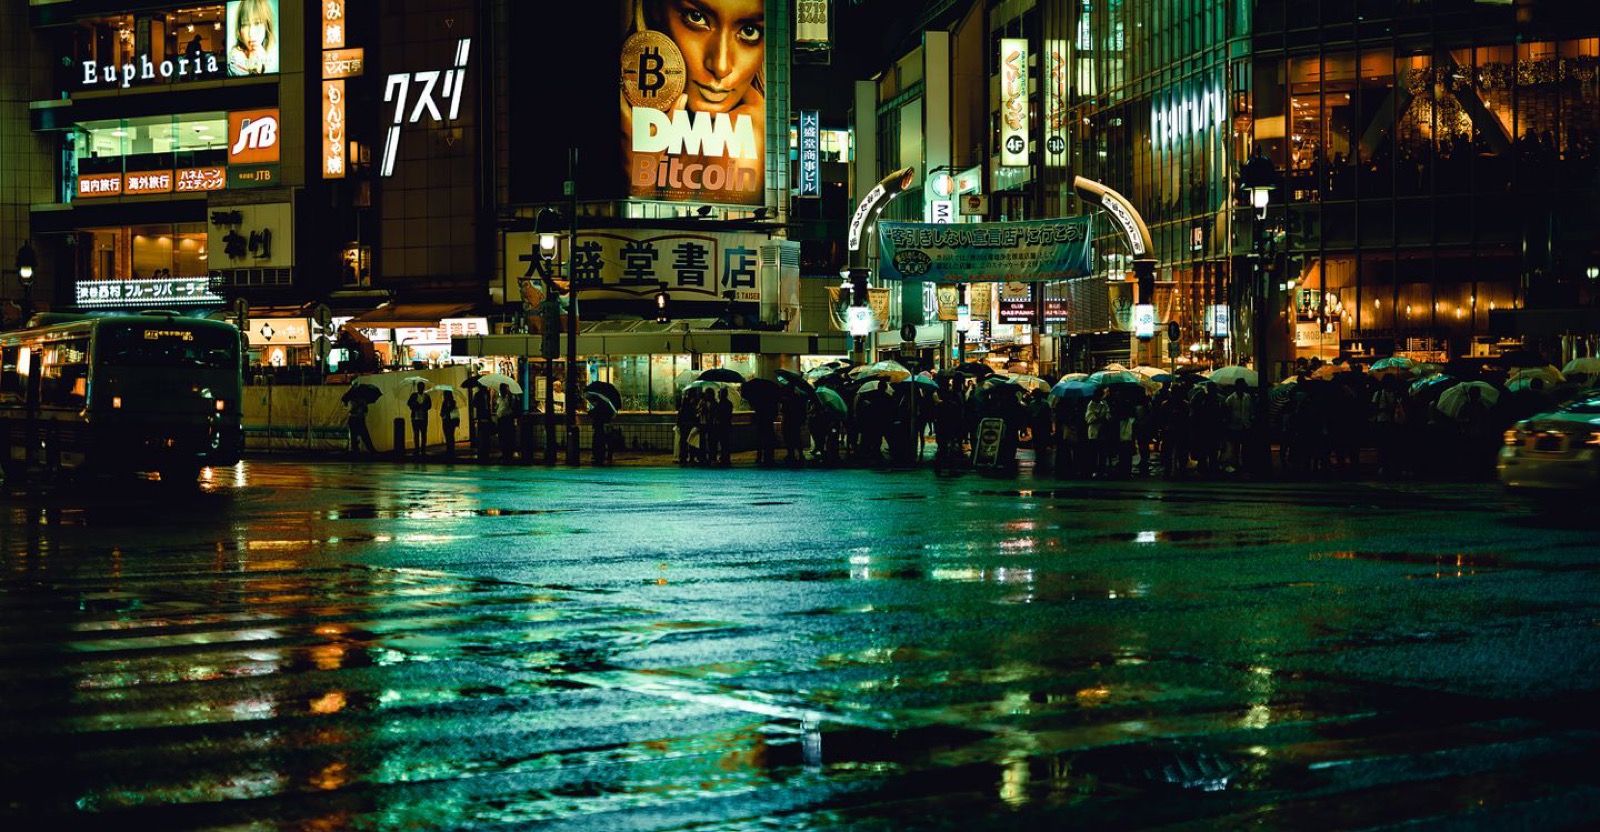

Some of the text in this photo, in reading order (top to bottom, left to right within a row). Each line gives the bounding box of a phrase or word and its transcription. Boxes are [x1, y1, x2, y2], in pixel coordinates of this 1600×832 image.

[82, 51, 219, 88] Euphoria
[381, 38, 473, 177] クスリ
[232, 117, 277, 156] JTB
[632, 106, 758, 160] DMM
[1007, 137, 1023, 151] 4F
[181, 168, 222, 179] ハネムーン
[632, 154, 757, 193] Bitcoin
[804, 114, 816, 195] 大盛堂商事ビル
[80, 179, 120, 193] 国内旅行
[128, 175, 171, 191] 海外旅行
[255, 170, 271, 181] JTB
[518, 241, 757, 289] 大盛堂書店
